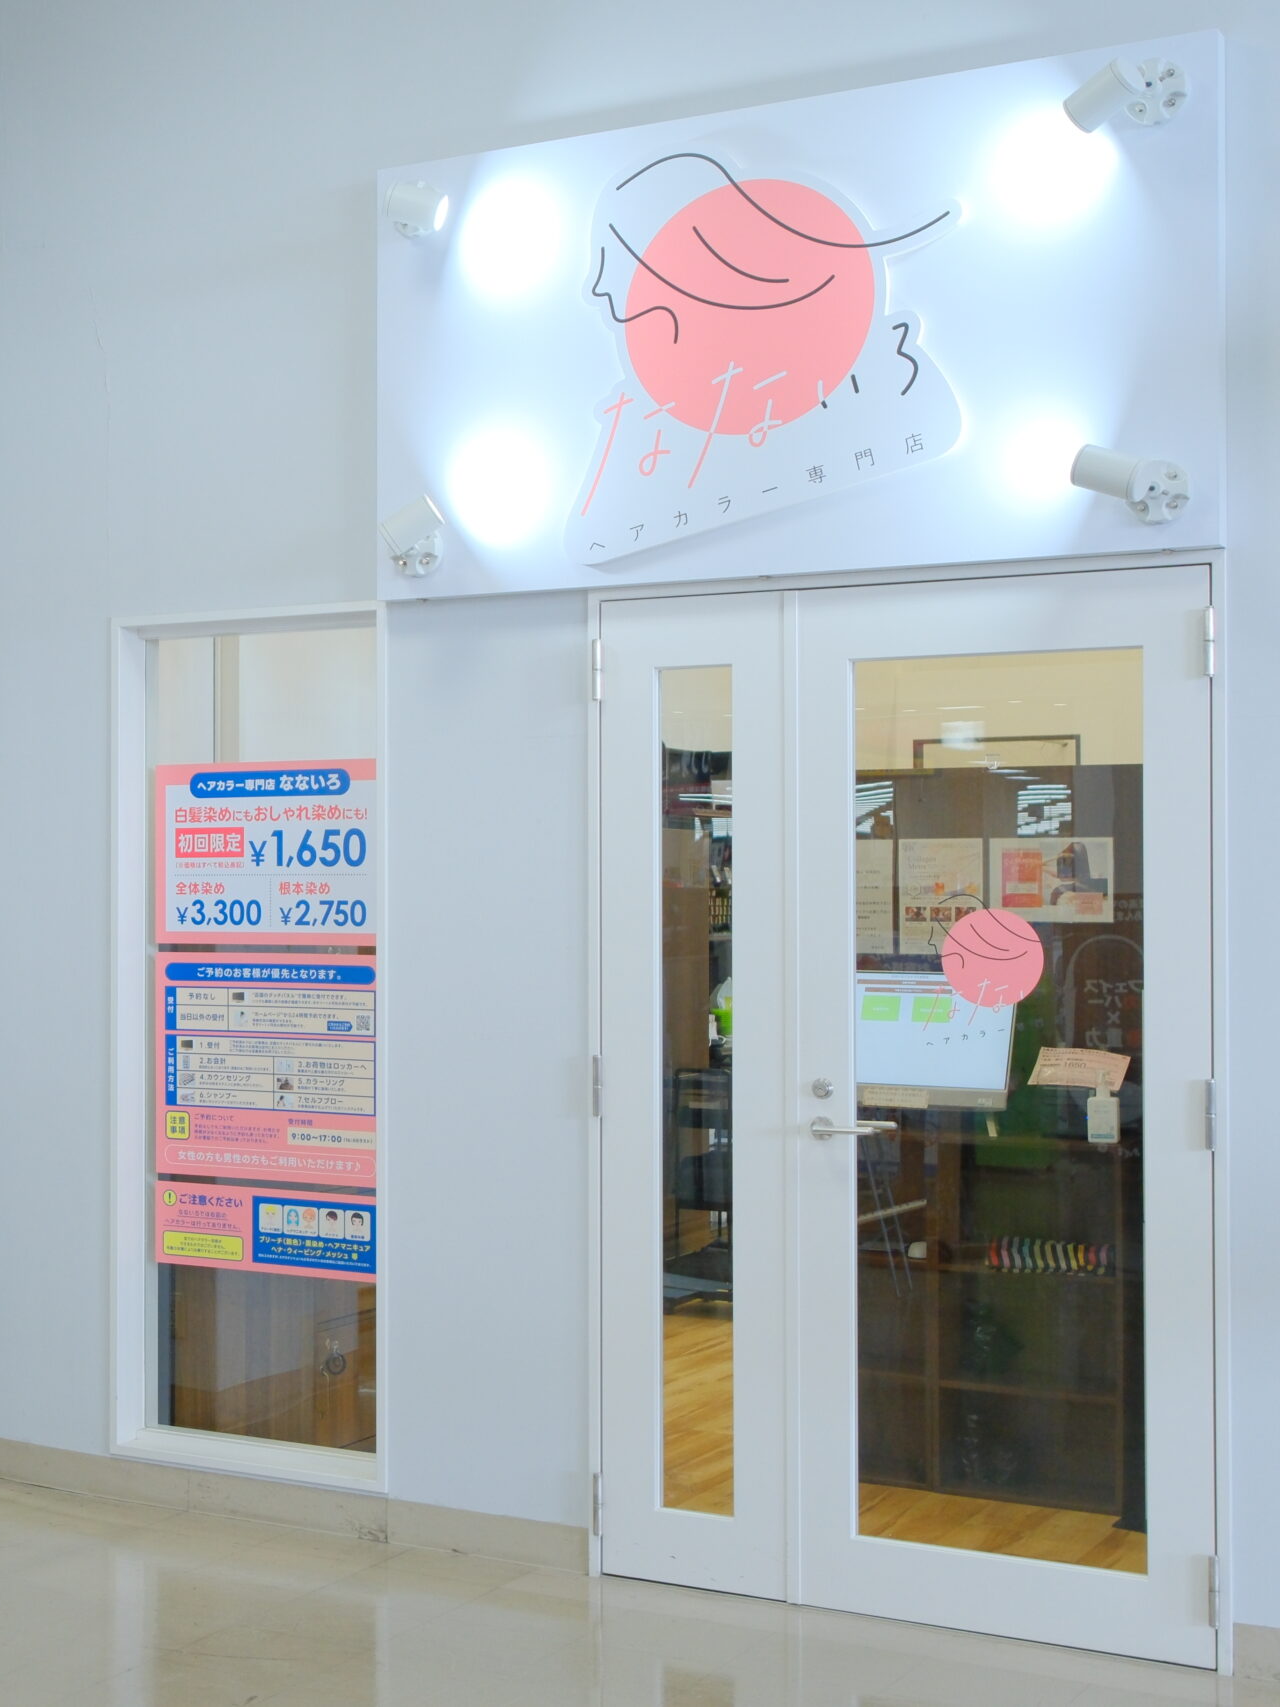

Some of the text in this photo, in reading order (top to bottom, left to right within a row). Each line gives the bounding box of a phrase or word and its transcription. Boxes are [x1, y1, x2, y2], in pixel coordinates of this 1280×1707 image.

[580, 321, 919, 517] なないろ
[588, 432, 925, 552] ヘアカラー専門店
[197, 773, 342, 791] ヘアカラー専門店 なないろ
[178, 833, 241, 853] 初回限定
[248, 827, 367, 868] ¥1,650
[175, 881, 225, 895] 全体染め
[278, 881, 331, 895] 根本染め
[176, 898, 262, 926] ¥3,300
[279, 898, 367, 927] ¥2,750
[196, 967, 342, 981] ご予約のお客様が優先となります。
[288, 1118, 313, 1126] 受付時間
[179, 1193, 243, 1208] ご注意ください
